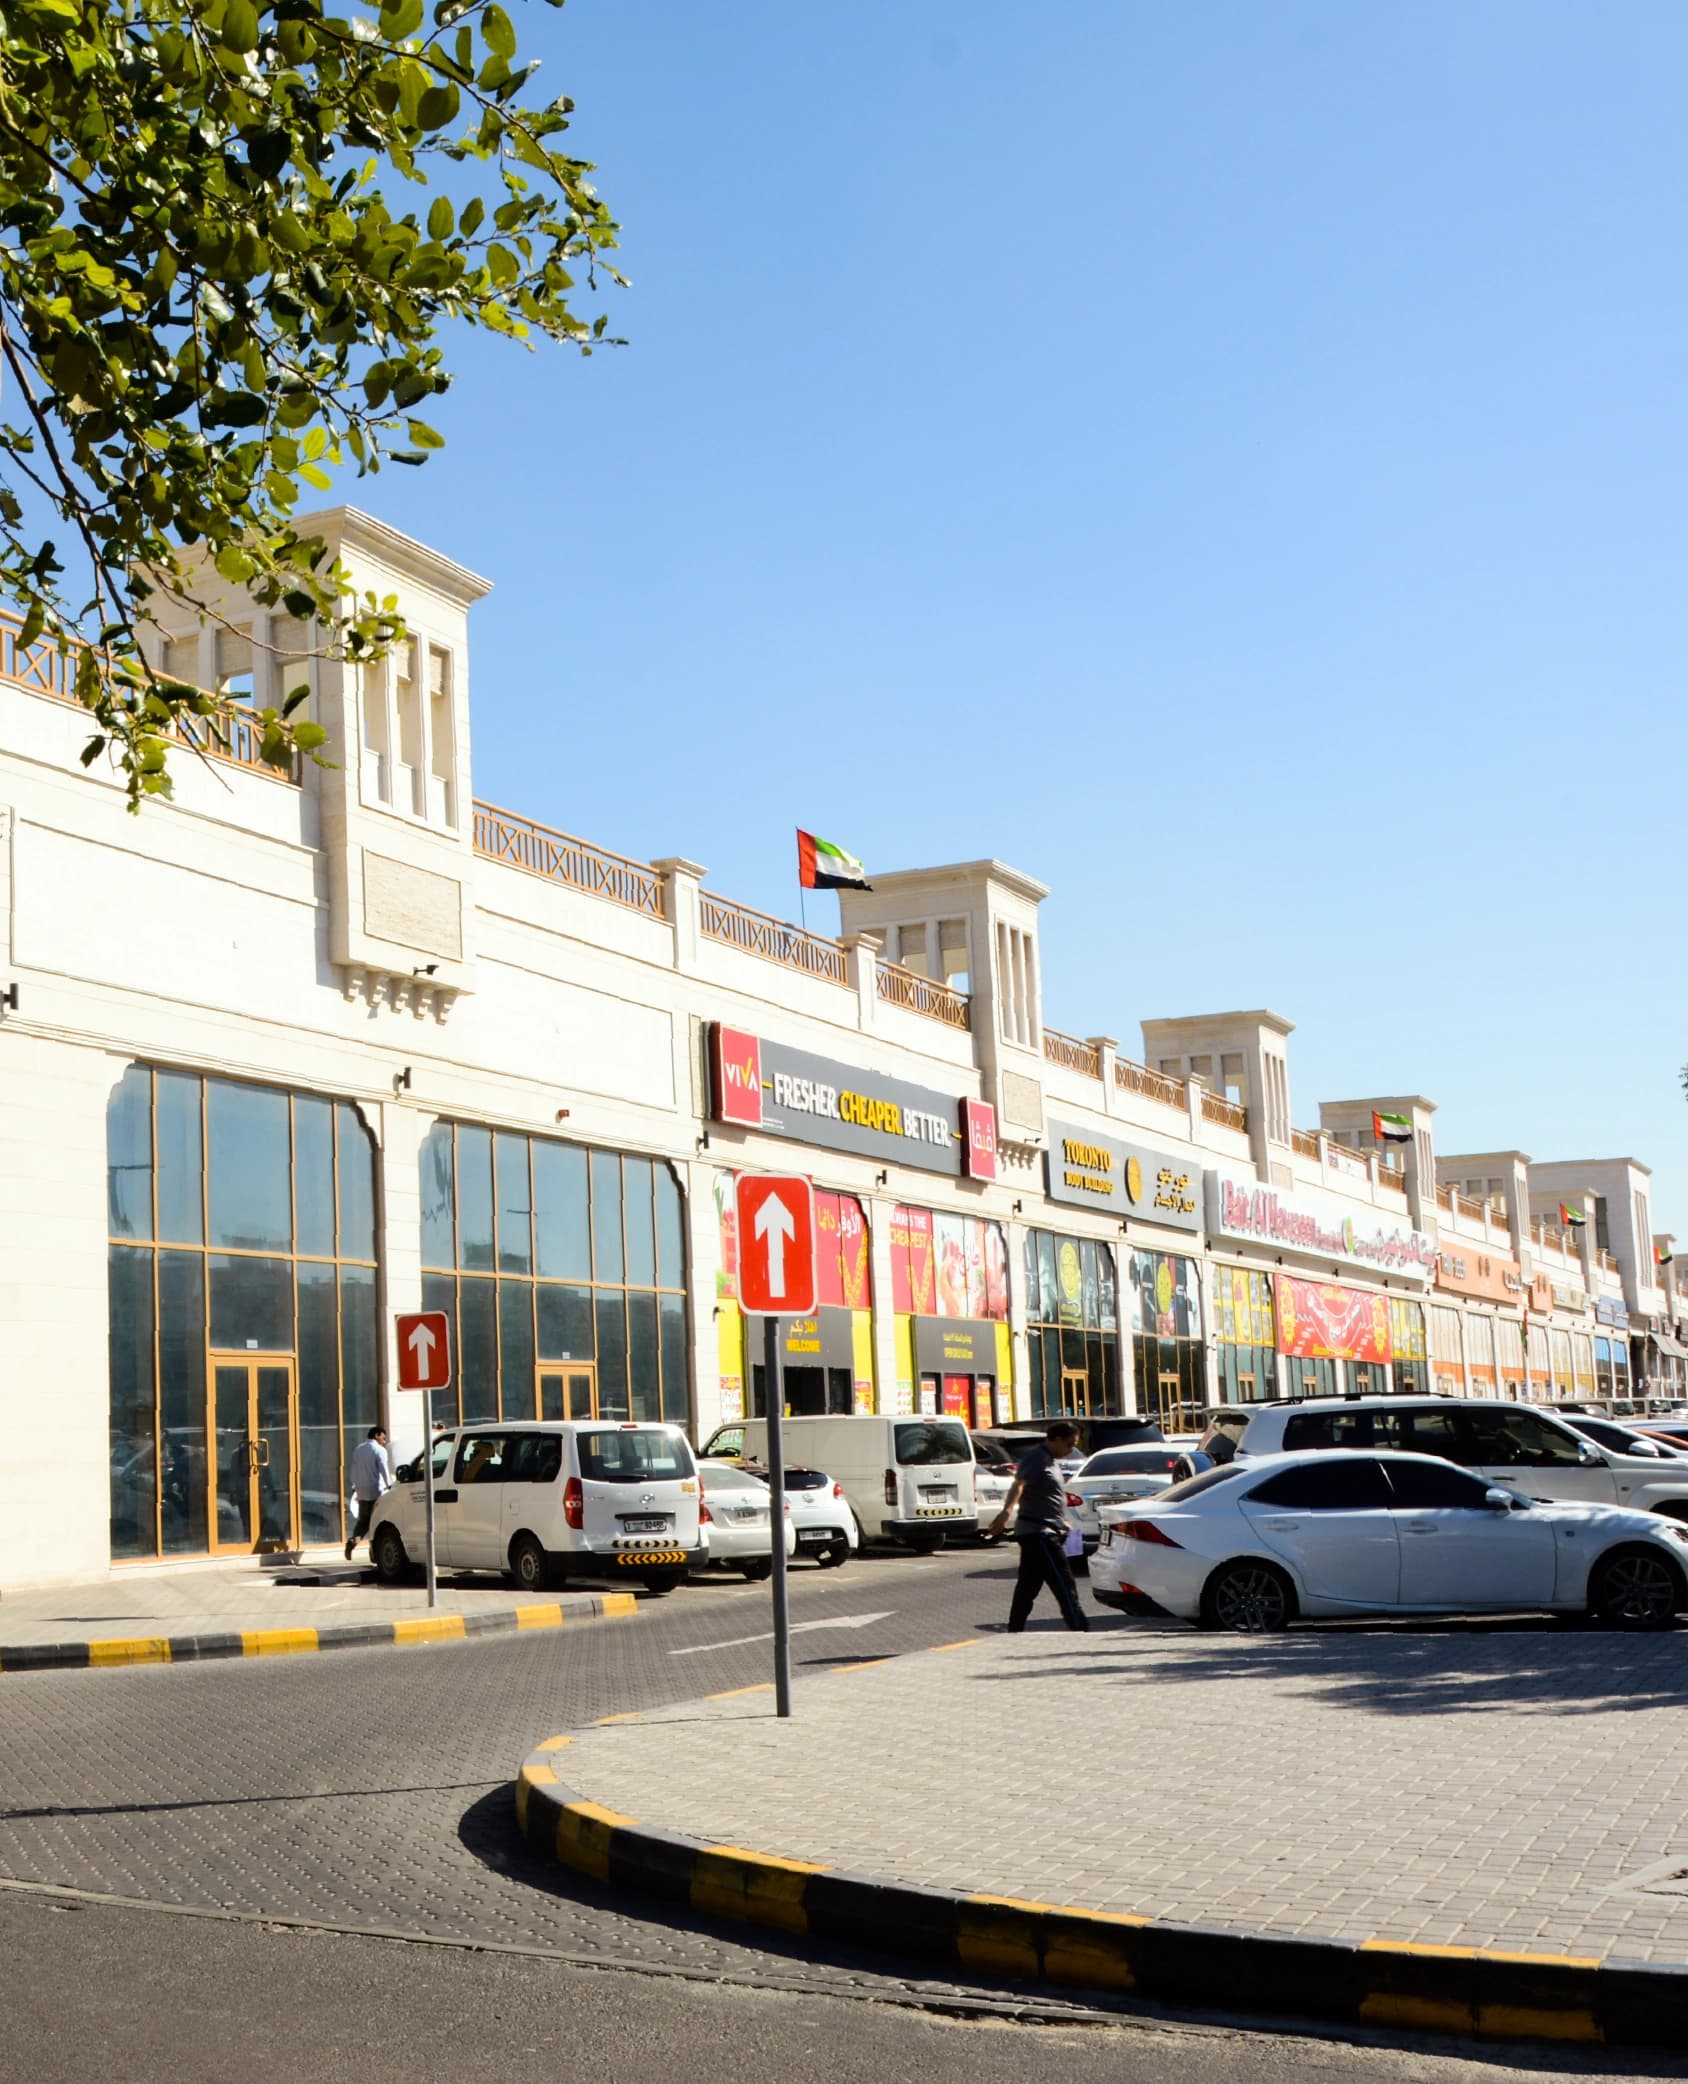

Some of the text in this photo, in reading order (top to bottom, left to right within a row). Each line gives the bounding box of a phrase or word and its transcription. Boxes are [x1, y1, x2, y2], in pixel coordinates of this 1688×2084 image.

[725, 1057, 759, 1092] VIVA
[773, 1072, 952, 1148] FRESHER. CHEAPER. BETTER.
[1063, 1138, 1112, 1173] TORONTO
[889, 1228, 929, 1249] CHEAPEST
[912, 1215, 927, 1230] THE
